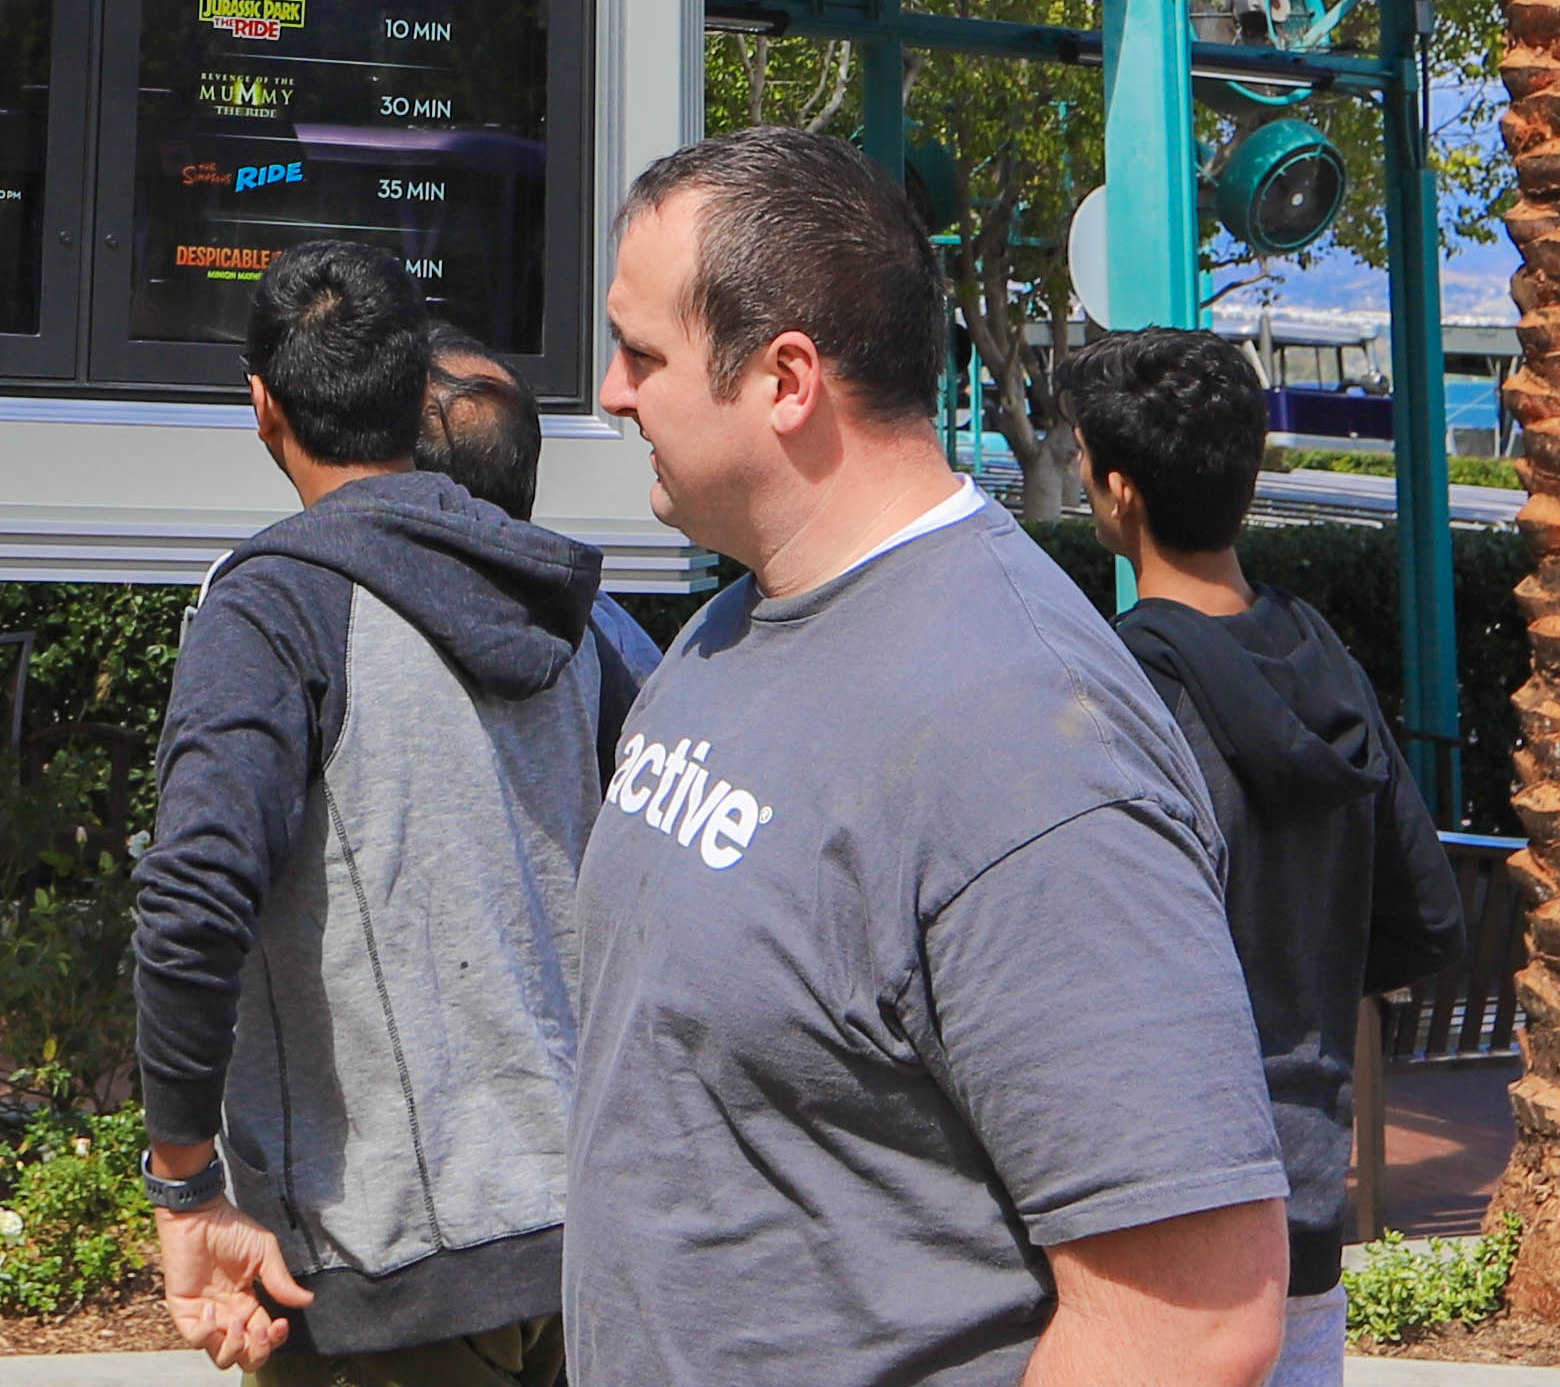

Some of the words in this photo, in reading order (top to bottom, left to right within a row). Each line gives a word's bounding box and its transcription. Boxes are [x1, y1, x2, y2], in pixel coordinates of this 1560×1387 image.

[214, 17, 234, 26] THE
[234, 18, 279, 38] RIDE
[385, 19, 409, 41] 10
[413, 22, 451, 42] MIN
[200, 72, 250, 83] REVENGE
[255, 76, 269, 84] OF
[274, 77, 295, 86] THE
[199, 81, 294, 106] MUMMY
[214, 105, 242, 116] THE
[245, 107, 277, 118] RIDE
[380, 96, 409, 116] 30
[413, 99, 451, 118] MIN
[234, 161, 304, 193] RIDE
[6, 189, 22, 200] PM
[377, 179, 403, 199] 35
[406, 181, 445, 201] MIN
[176, 245, 271, 270] DESPICABLE
[405, 259, 443, 279] MIN
